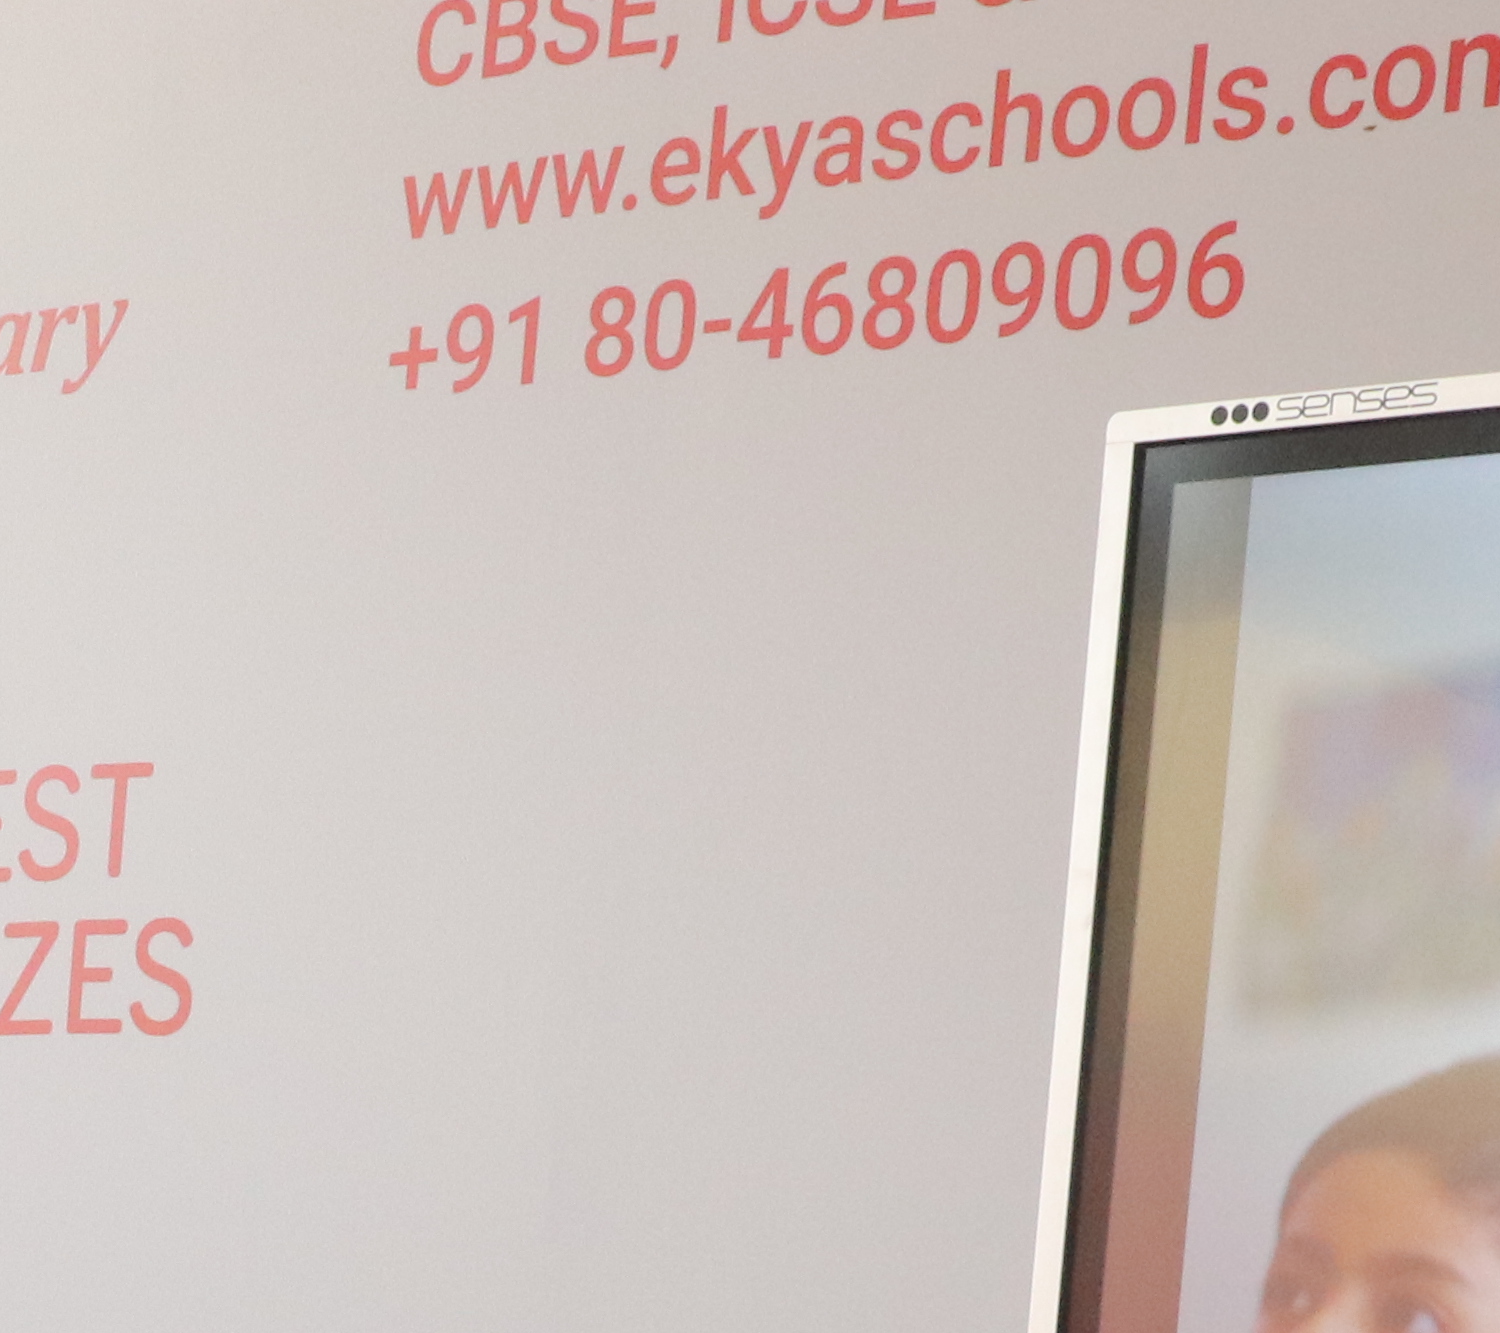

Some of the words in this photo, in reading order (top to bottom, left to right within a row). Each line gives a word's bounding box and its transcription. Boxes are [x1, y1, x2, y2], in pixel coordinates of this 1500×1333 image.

[418, 0, 678, 86] CBSE,
[390, 297, 540, 392] +91
[586, 220, 1245, 376] 80-46809096
[1275, 382, 1438, 421] senses
